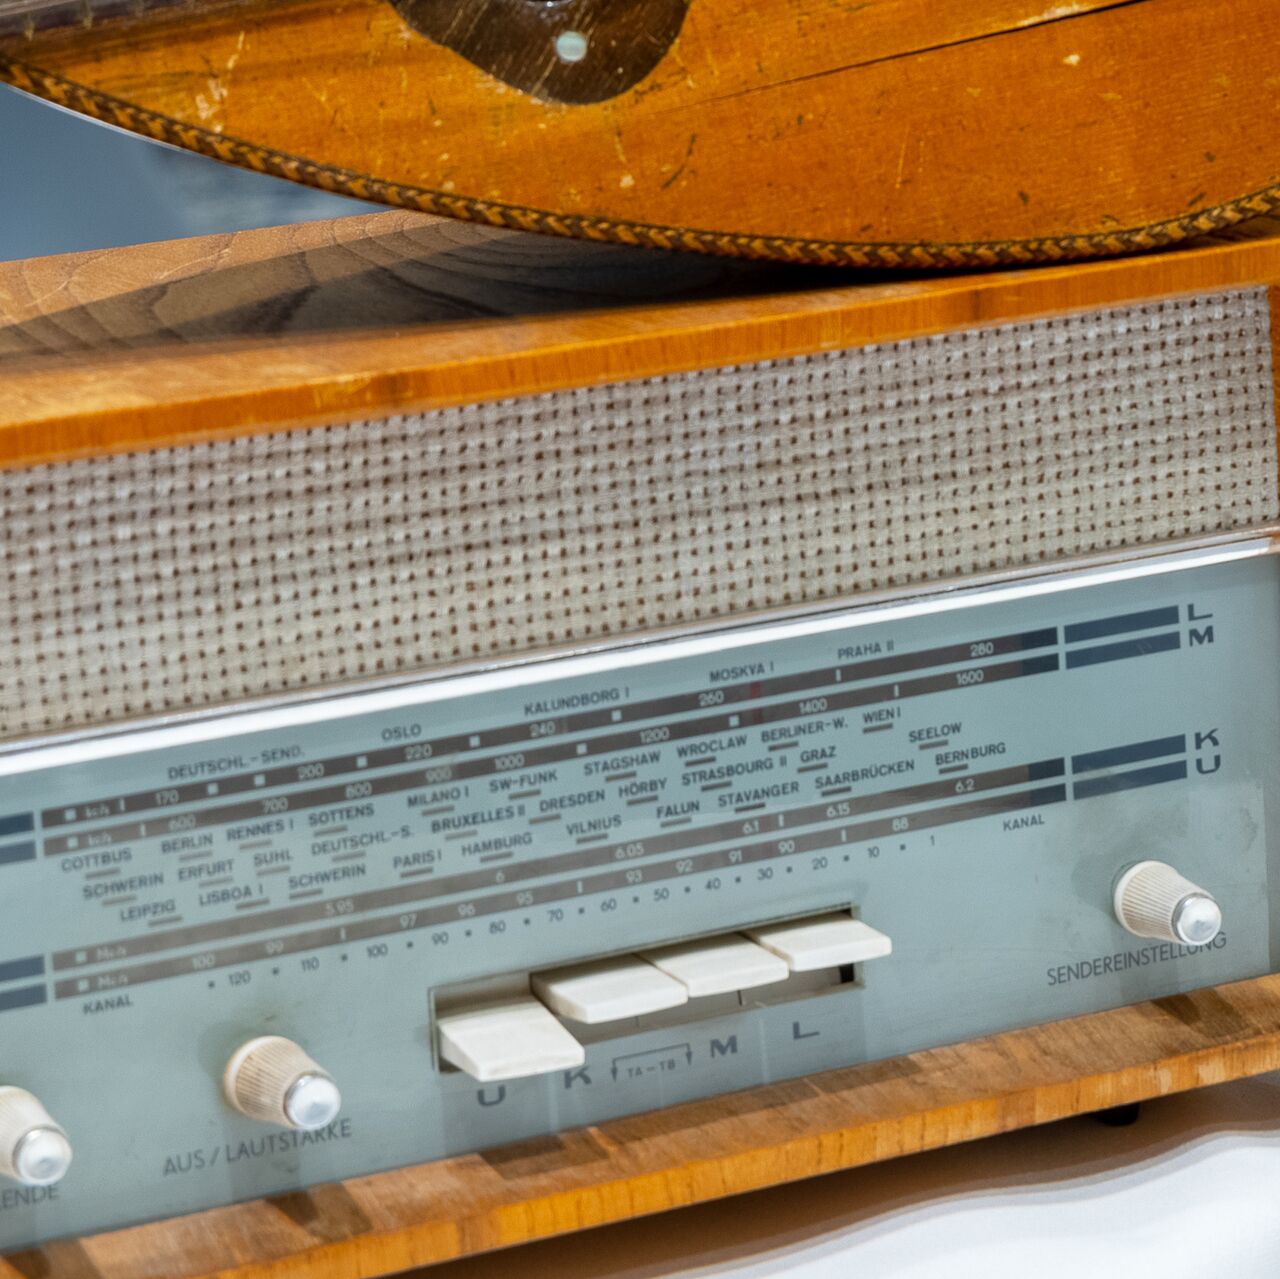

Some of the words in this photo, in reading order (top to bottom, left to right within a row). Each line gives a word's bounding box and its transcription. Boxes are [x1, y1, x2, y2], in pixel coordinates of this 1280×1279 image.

[1187, 603, 1214, 621] L
[1188, 625, 1214, 647] M
[837, 642, 881, 660] PRAHA
[970, 642, 994, 657] 280
[709, 662, 765, 683] MOSKVA
[956, 669, 984, 685] 1600
[524, 687, 620, 716] KALUNDBORG
[698, 690, 724, 707] 260
[799, 698, 828, 715] 1400
[863, 708, 895, 724] WIEN
[381, 724, 421, 742] OSLO
[529, 721, 556, 738] 240
[640, 727, 670, 744] 1200
[908, 722, 962, 743] SEELOW
[1194, 728, 1219, 750] K
[676, 734, 748, 759] WROCLAW
[800, 746, 837, 764] GRAZ
[935, 742, 1006, 765] BERNBURG
[494, 754, 525, 771] 1000
[584, 751, 661, 776] STAGSHAW
[681, 757, 773, 787] STRASBOURG
[1195, 754, 1221, 775] U
[489, 770, 558, 794] SW-FUNK
[815, 759, 915, 789] SAARBRÜCKEN
[618, 777, 668, 799] HÖRBY
[718, 780, 799, 808] STAVANGER
[955, 778, 975, 793] 6.2
[156, 790, 179, 806] 170
[407, 787, 461, 808] MILANO
[539, 789, 606, 813] DRESDEN
[308, 803, 374, 826] SOTTENS
[656, 800, 700, 819] FALUN
[826, 802, 850, 818] 6.15
[431, 807, 515, 834] BRUXELLES
[566, 814, 622, 836] VILNIUS
[742, 820, 759, 834] 6.1
[1003, 813, 1045, 832] KANAL
[226, 821, 285, 840] RENNES
[161, 834, 213, 853] BERLIN
[461, 832, 533, 856] HAMBURG
[615, 842, 645, 860] 6.05
[778, 839, 795, 853] 90
[867, 846, 880, 859] 10
[61, 848, 132, 872] COTTBUS
[254, 849, 292, 867] SUHL
[393, 851, 434, 869] PARIS
[728, 850, 742, 864] 91
[812, 857, 828, 871] 20
[178, 859, 234, 881] ERFURT
[289, 864, 366, 888] SCHWERIN
[757, 867, 773, 881] 30
[83, 872, 164, 899] SCHWERIN
[705, 878, 721, 891] 40
[199, 885, 252, 907] LISBOA
[653, 887, 669, 902] 50
[120, 900, 176, 922] LEIPZIG
[601, 898, 617, 912] 60
[547, 909, 564, 922] 70
[489, 920, 506, 935] 80
[432, 932, 449, 945] 90
[366, 944, 388, 958] 100
[301, 957, 320, 971] 110
[228, 971, 251, 987] 120
[83, 995, 134, 1014] KANAL
[792, 1021, 820, 1041] L
[709, 1035, 738, 1059] M
[563, 1066, 593, 1089] K
[476, 1085, 506, 1107] U
